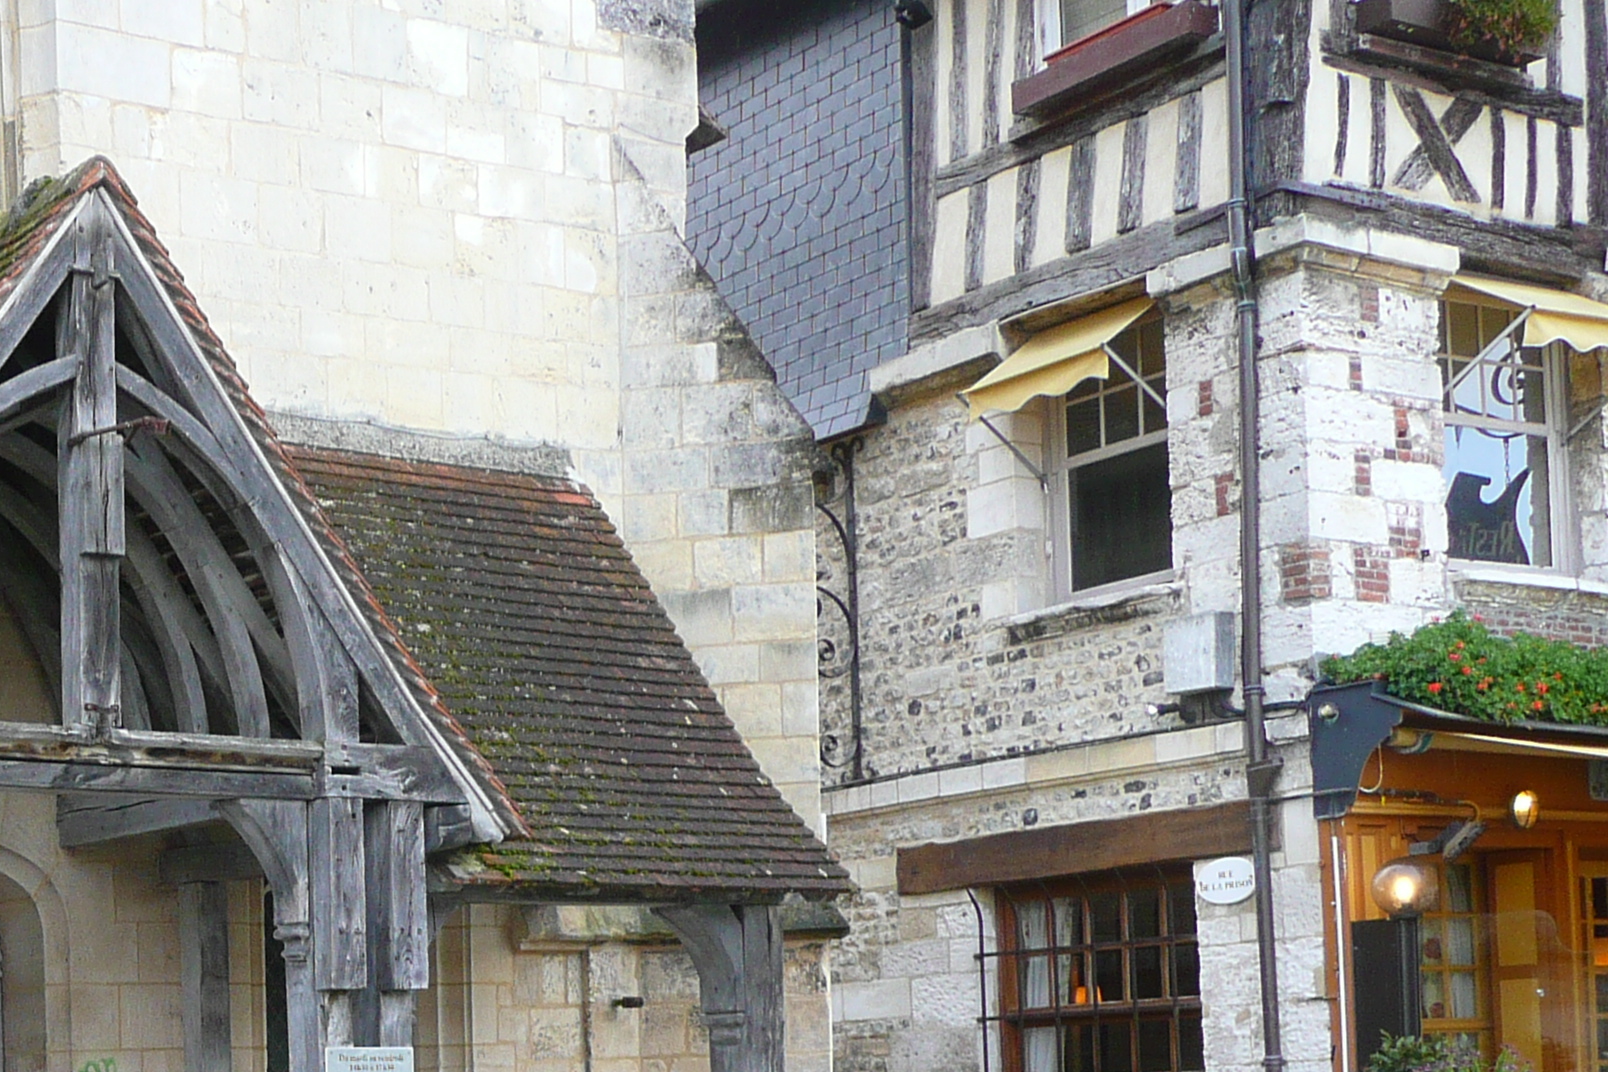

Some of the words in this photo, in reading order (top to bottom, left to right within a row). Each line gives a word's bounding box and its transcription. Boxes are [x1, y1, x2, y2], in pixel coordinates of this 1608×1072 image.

[1218, 870, 1233, 878] RUE
[1212, 882, 1223, 891] LA
[1225, 879, 1253, 890] PRISON
